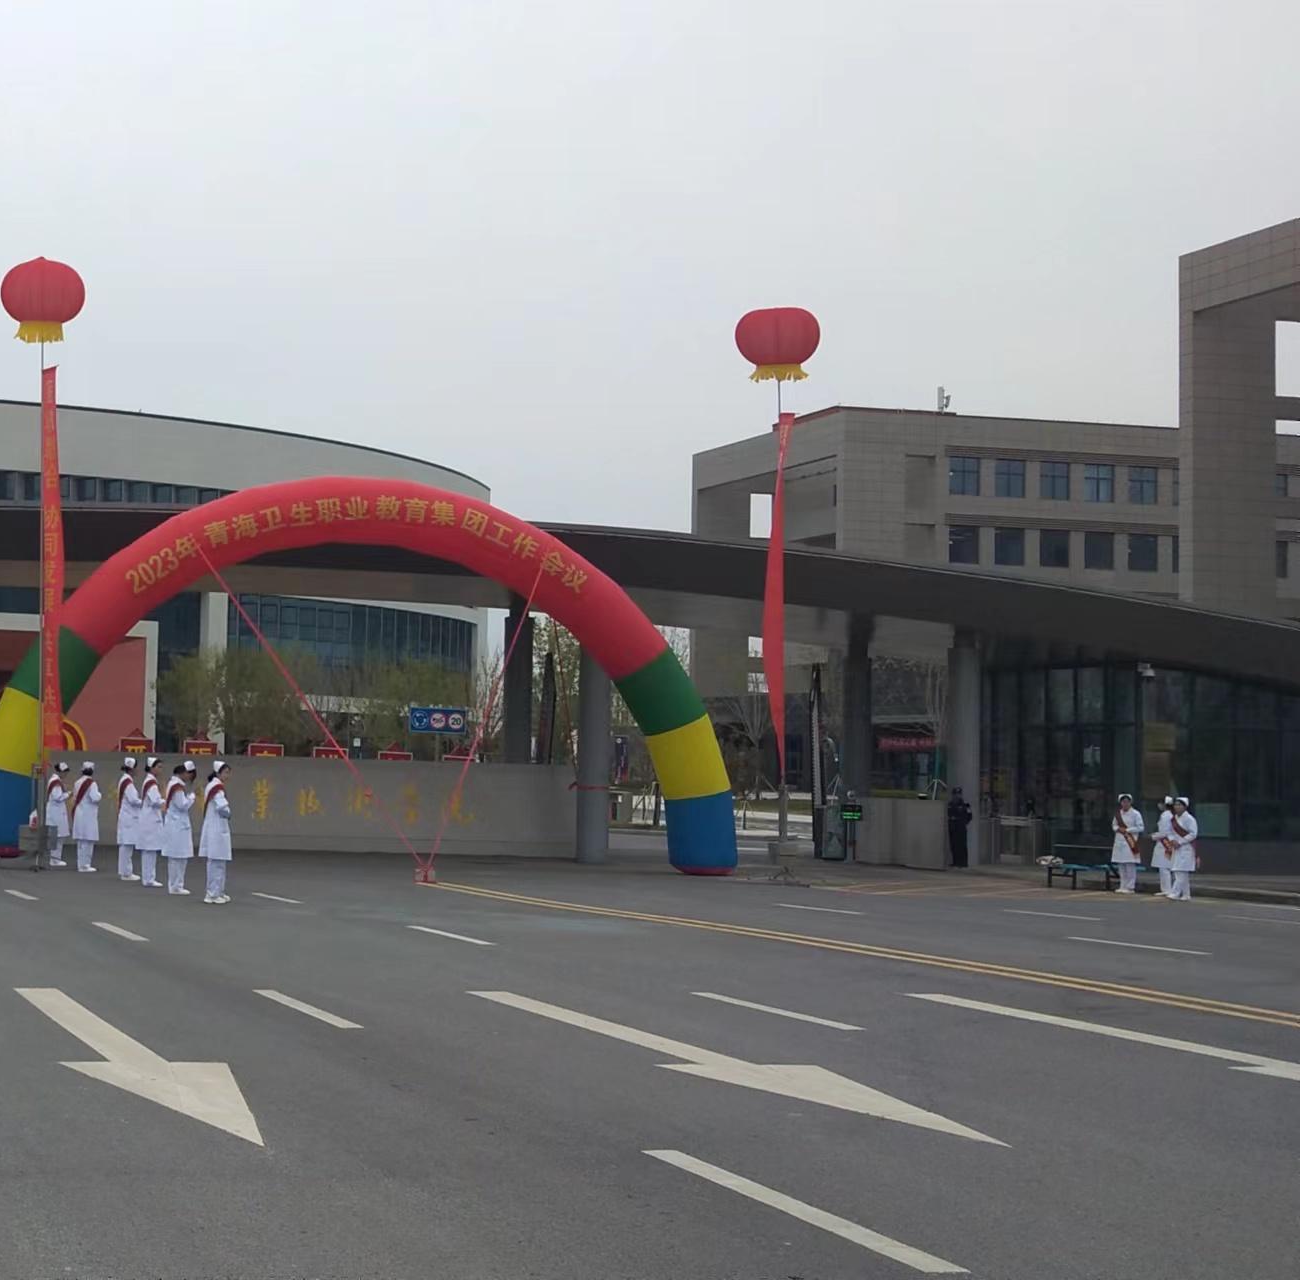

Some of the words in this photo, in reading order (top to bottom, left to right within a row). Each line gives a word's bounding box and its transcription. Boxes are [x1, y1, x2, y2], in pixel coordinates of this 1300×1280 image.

[125, 495, 588, 594] 2023年青海卫生职业教育集团工作会议
[451, 715, 462, 726] 20
